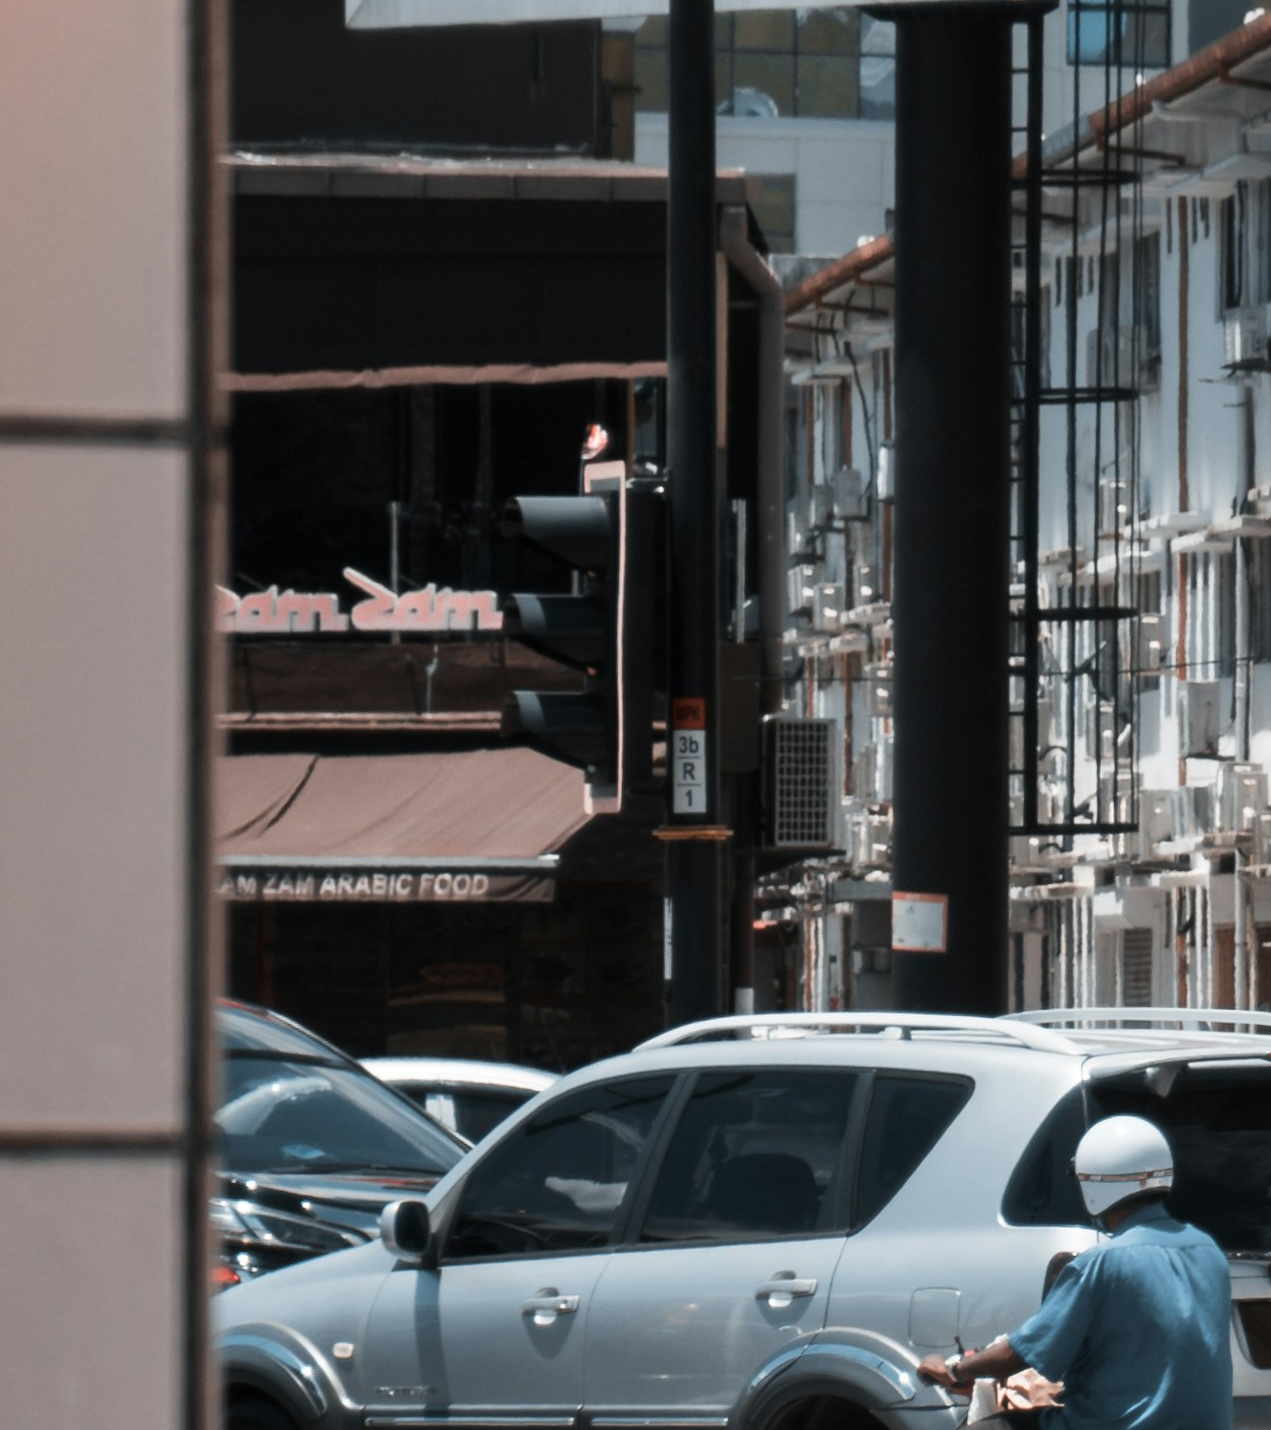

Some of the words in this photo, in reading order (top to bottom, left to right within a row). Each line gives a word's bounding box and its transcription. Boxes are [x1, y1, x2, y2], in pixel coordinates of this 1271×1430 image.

[678, 736, 700, 754] 3b
[682, 762, 696, 781] R
[684, 789, 693, 808] 1
[262, 874, 315, 895] ZAM
[319, 873, 413, 895] ARABIC
[419, 873, 490, 896] FOOD
